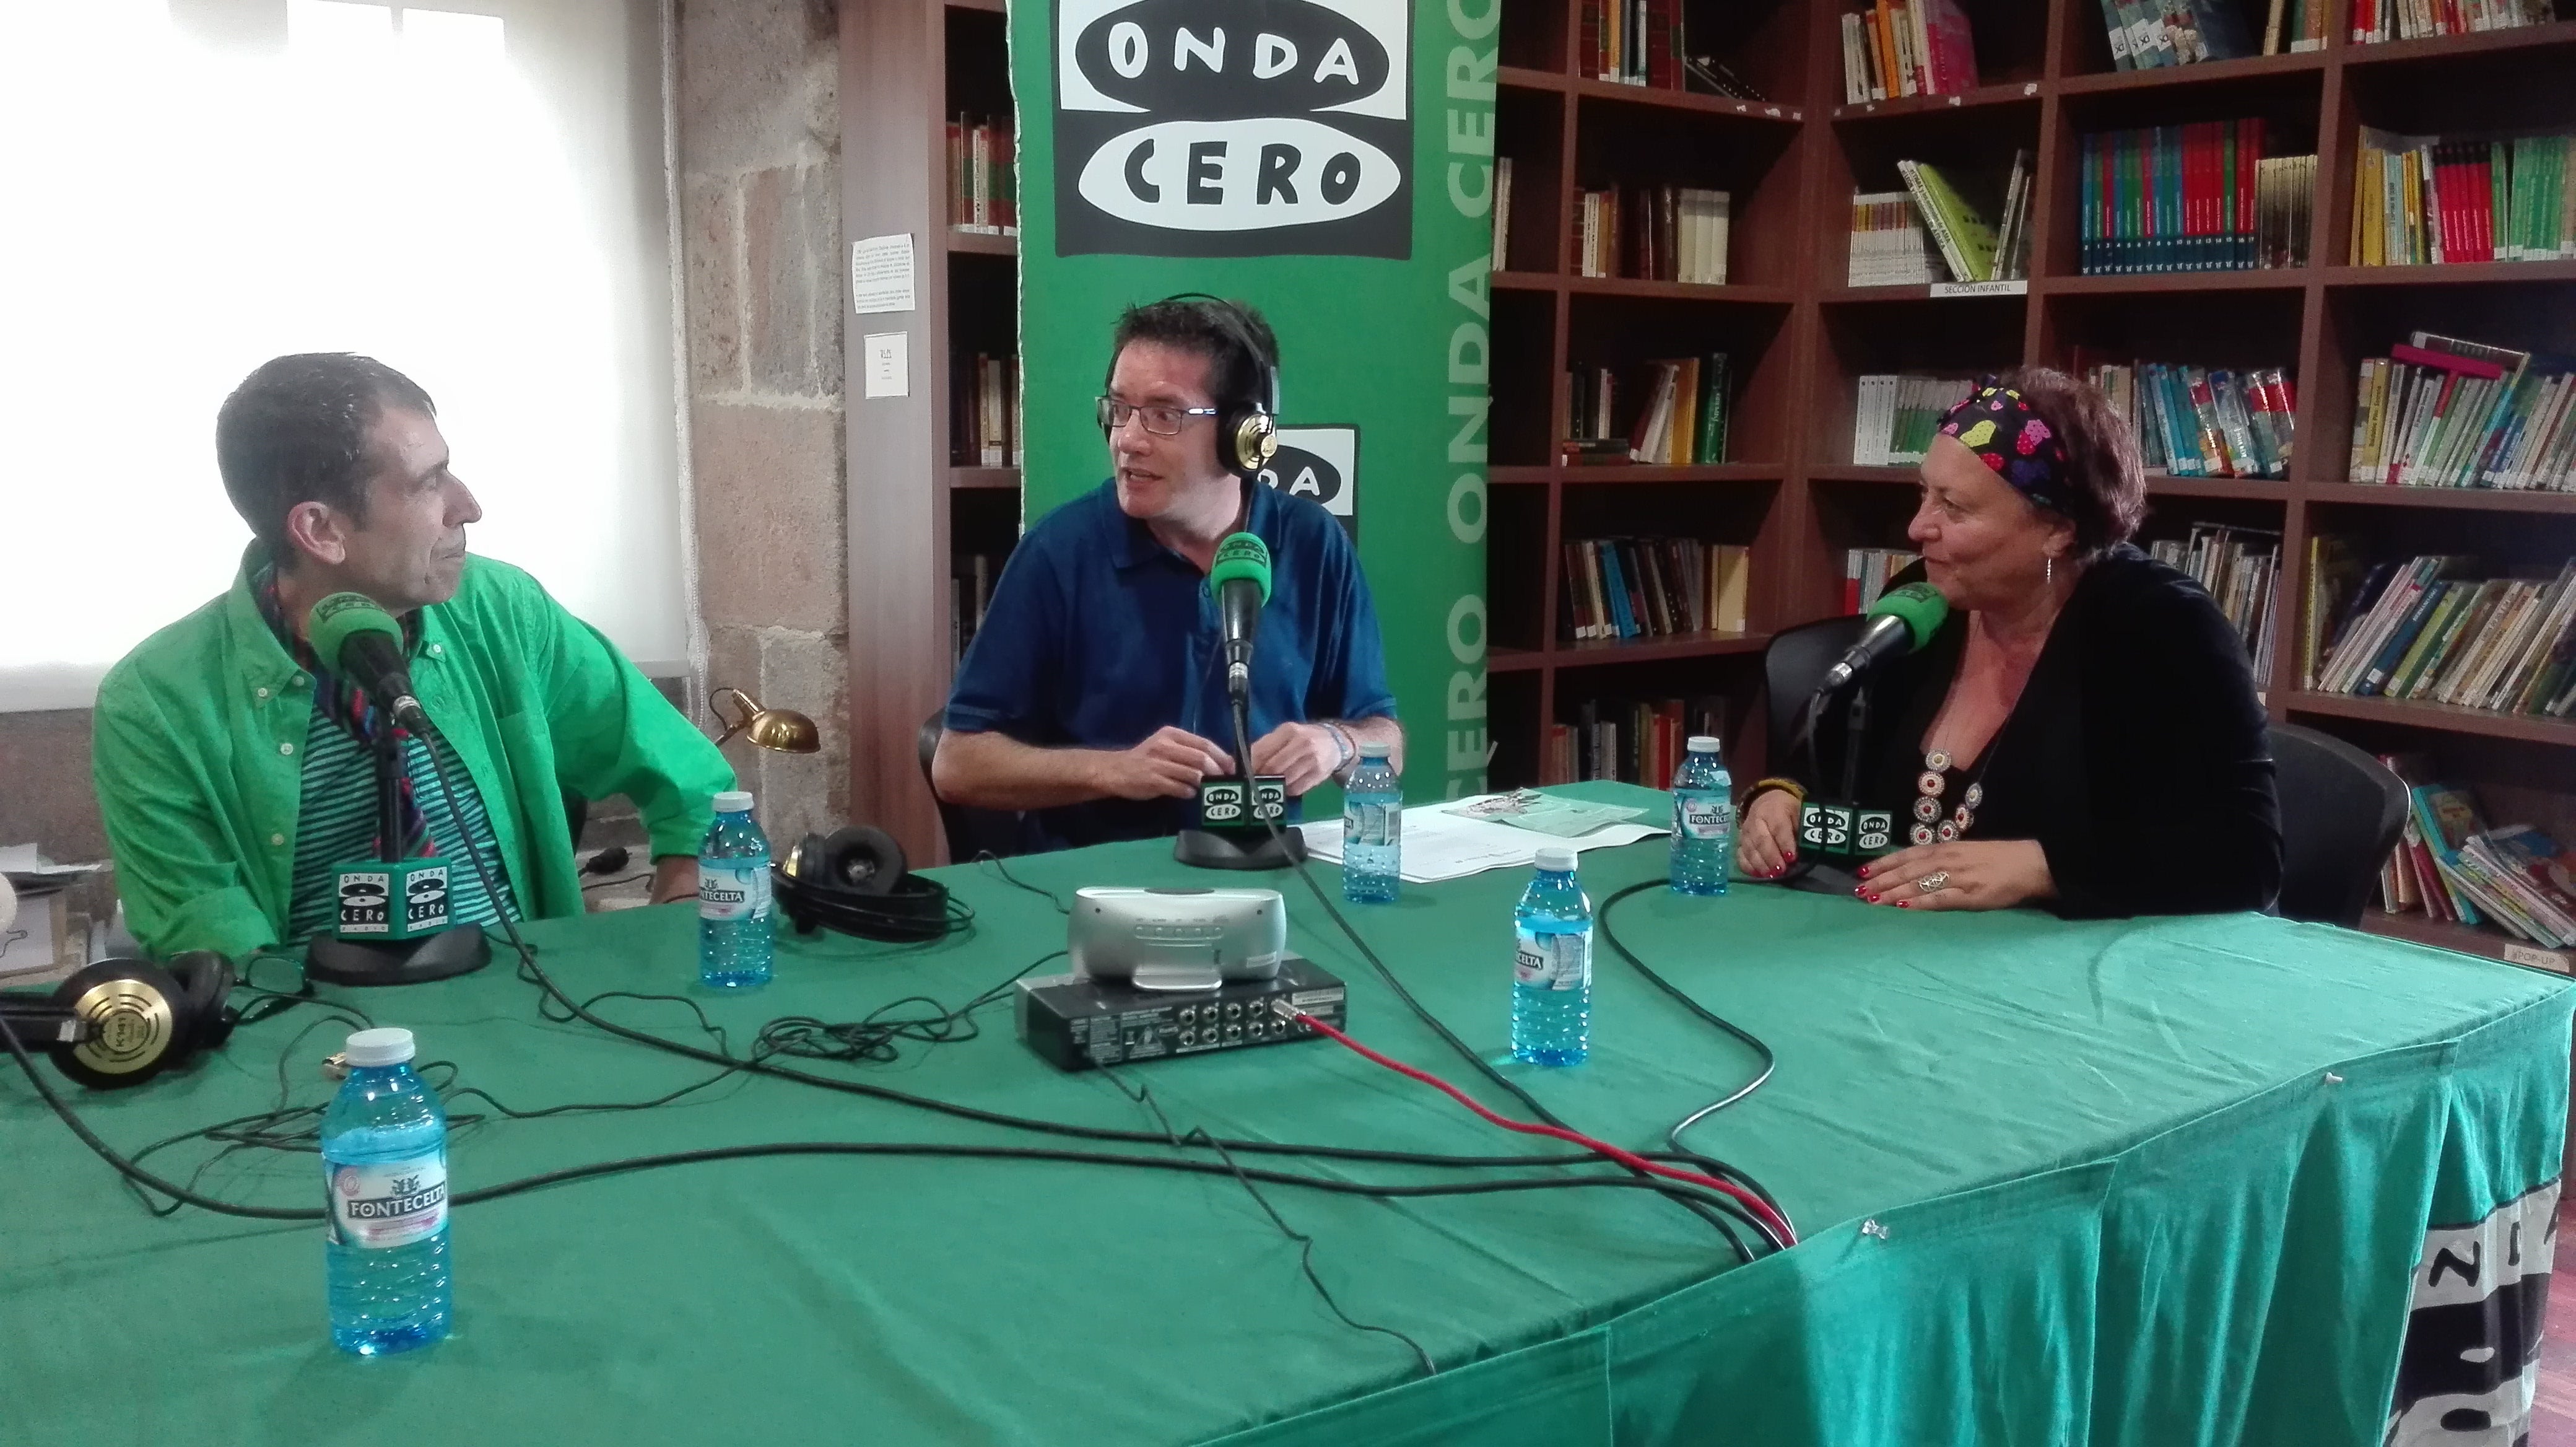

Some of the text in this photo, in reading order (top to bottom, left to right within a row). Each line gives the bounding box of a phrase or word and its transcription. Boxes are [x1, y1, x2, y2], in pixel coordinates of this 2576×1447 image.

[1107, 22, 1359, 85] ONDA
[1124, 138, 1361, 205] CERO
[1977, 284, 2011, 292] INFANTIL
[1448, 253, 1490, 544] ONDA
[1257, 466, 1320, 496] DA
[1208, 792, 1237, 802] ONDA
[1261, 792, 1280, 800] NDA
[1211, 807, 1237, 816] CERO
[1257, 807, 1279, 816] CRO
[1863, 821, 1887, 830] ONDA
[1863, 834, 1885, 846] CERO
[344, 875, 384, 883] ONDA
[411, 868, 443, 882] ONDA
[701, 890, 743, 903] NTECELTA
[341, 909, 384, 922] CERO
[407, 904, 444, 920] CERO
[1518, 953, 1542, 969] CELTA
